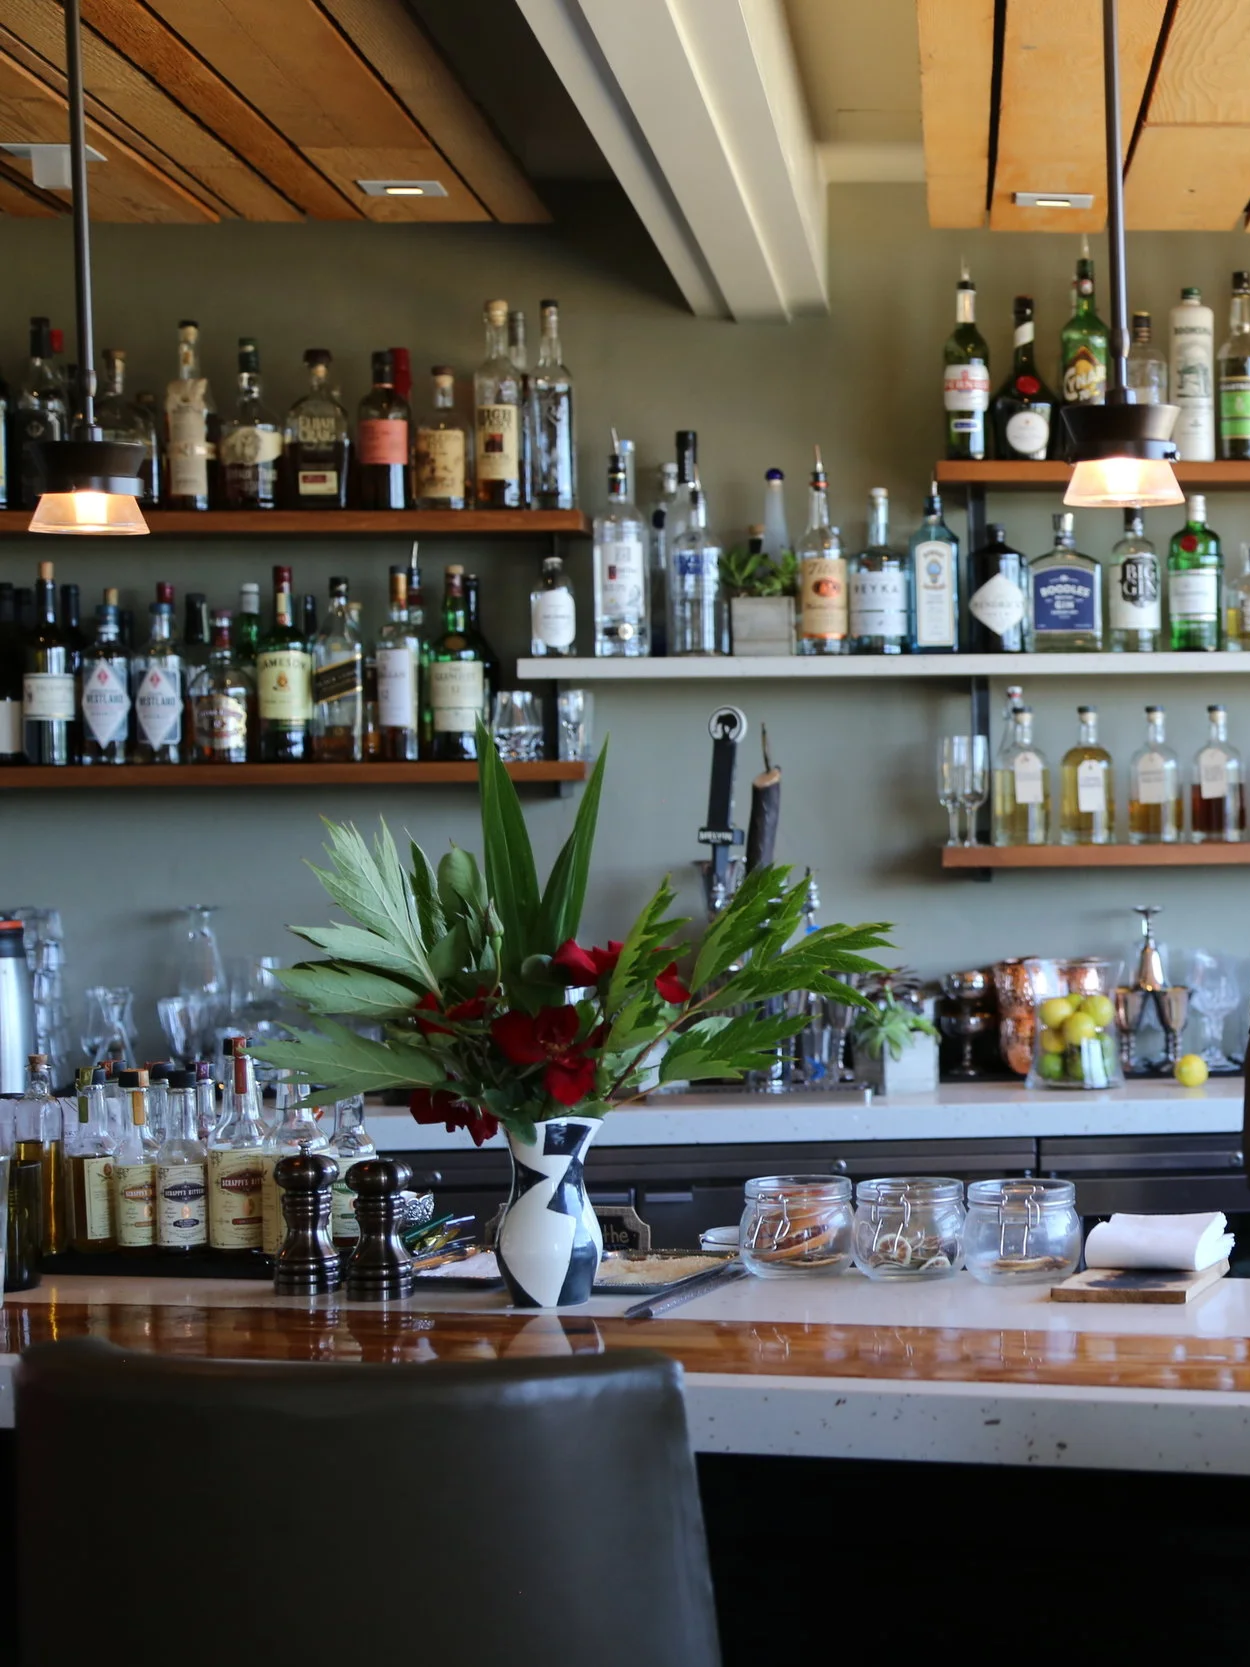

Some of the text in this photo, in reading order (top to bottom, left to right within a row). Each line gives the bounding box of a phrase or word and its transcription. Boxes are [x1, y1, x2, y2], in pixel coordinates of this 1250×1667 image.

[1125, 563, 1156, 580] BIG
[854, 584, 898, 594] REYKA
[1039, 583, 1092, 598] BOODLES
[1122, 579, 1156, 597] GIN
[86, 694, 124, 704] WESTLAND
[139, 696, 175, 706] WESTLAND
